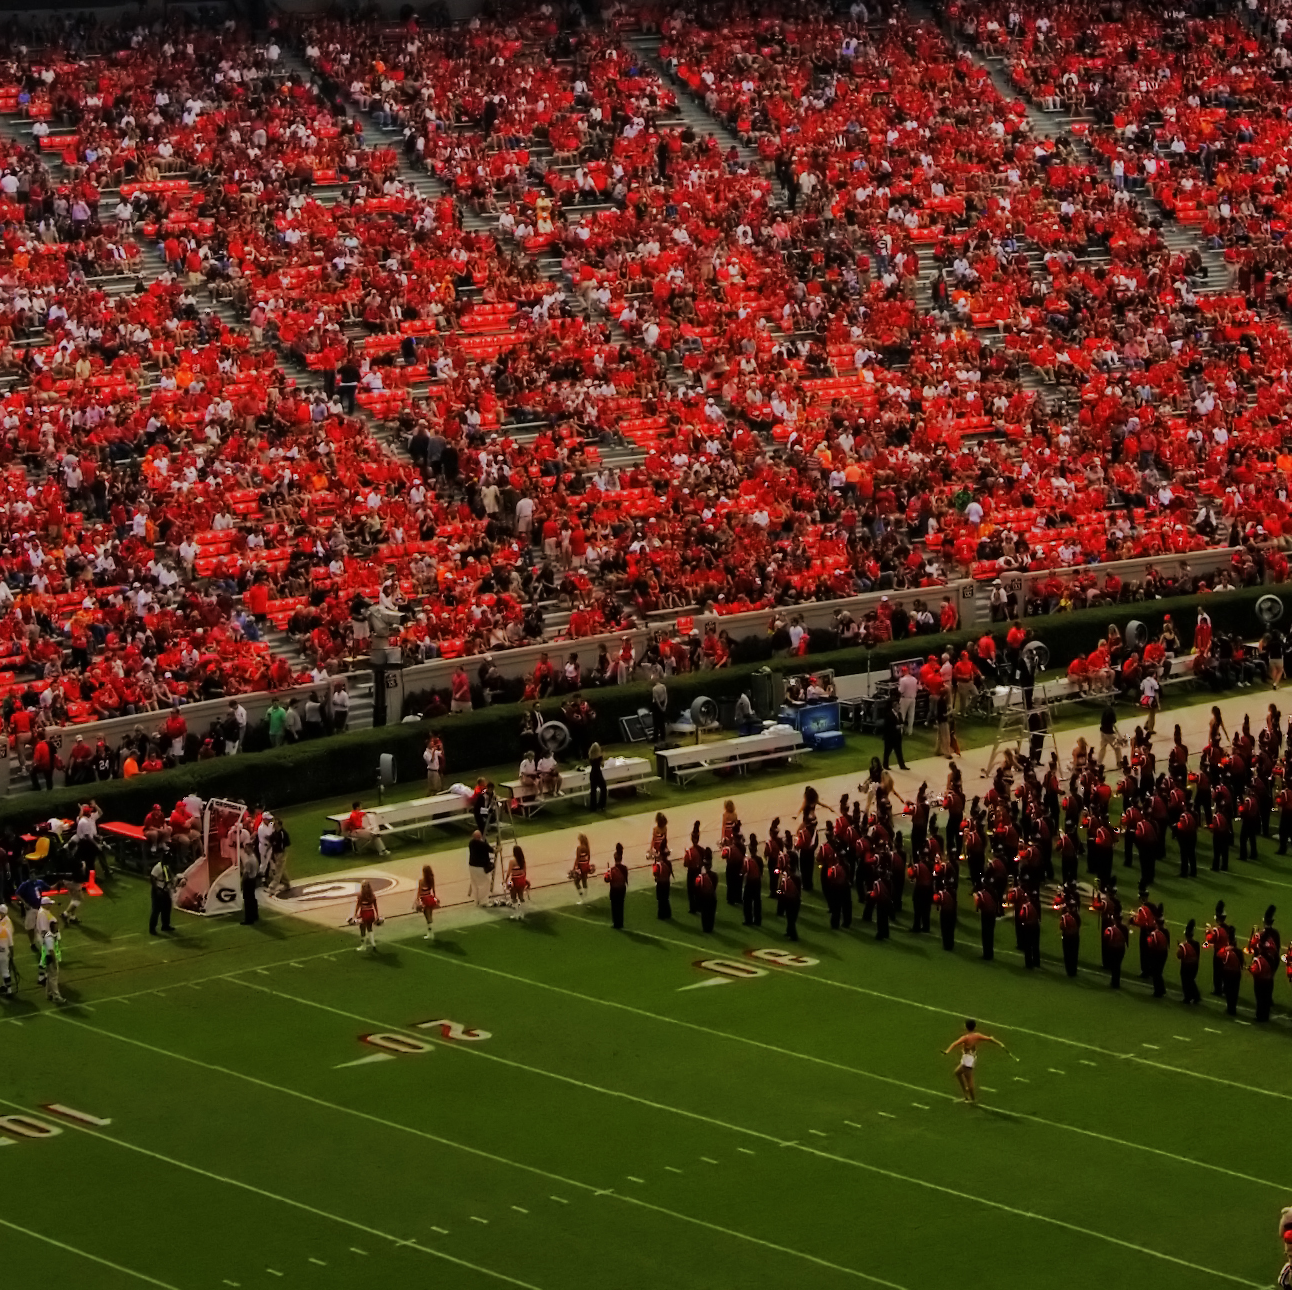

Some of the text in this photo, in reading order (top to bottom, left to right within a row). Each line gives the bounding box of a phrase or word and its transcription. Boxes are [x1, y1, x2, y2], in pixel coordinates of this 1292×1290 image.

[98, 759, 109, 770] 24
[215, 888, 237, 903] G
[691, 948, 820, 978] 30
[359, 1019, 493, 1053] 20
